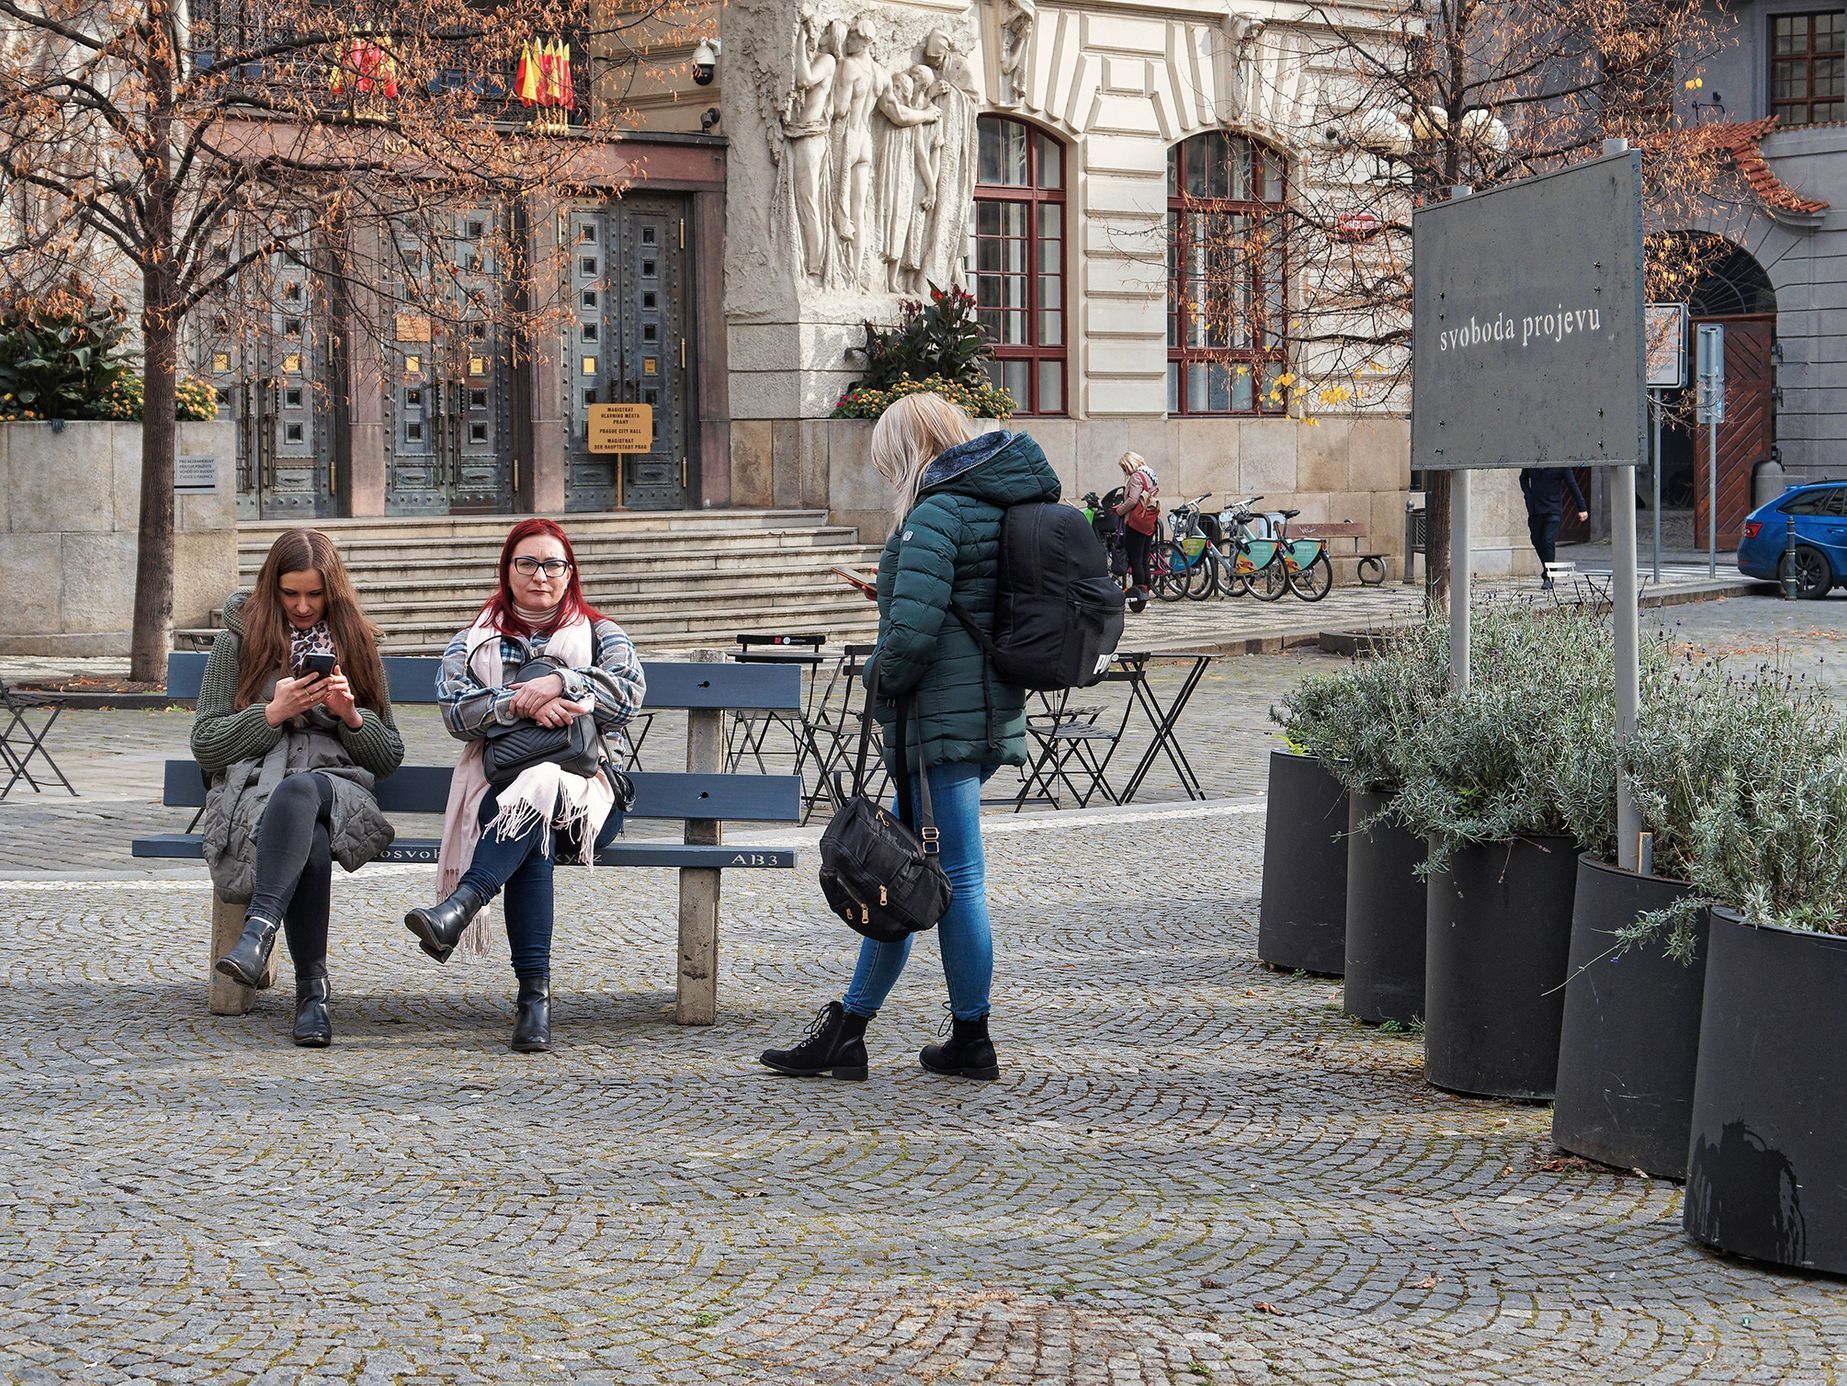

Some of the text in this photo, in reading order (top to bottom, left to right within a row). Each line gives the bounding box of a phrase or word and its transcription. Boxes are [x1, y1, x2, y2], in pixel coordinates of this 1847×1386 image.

[1439, 303, 1601, 352] svoboda projevu
[731, 853, 778, 866] AB3
